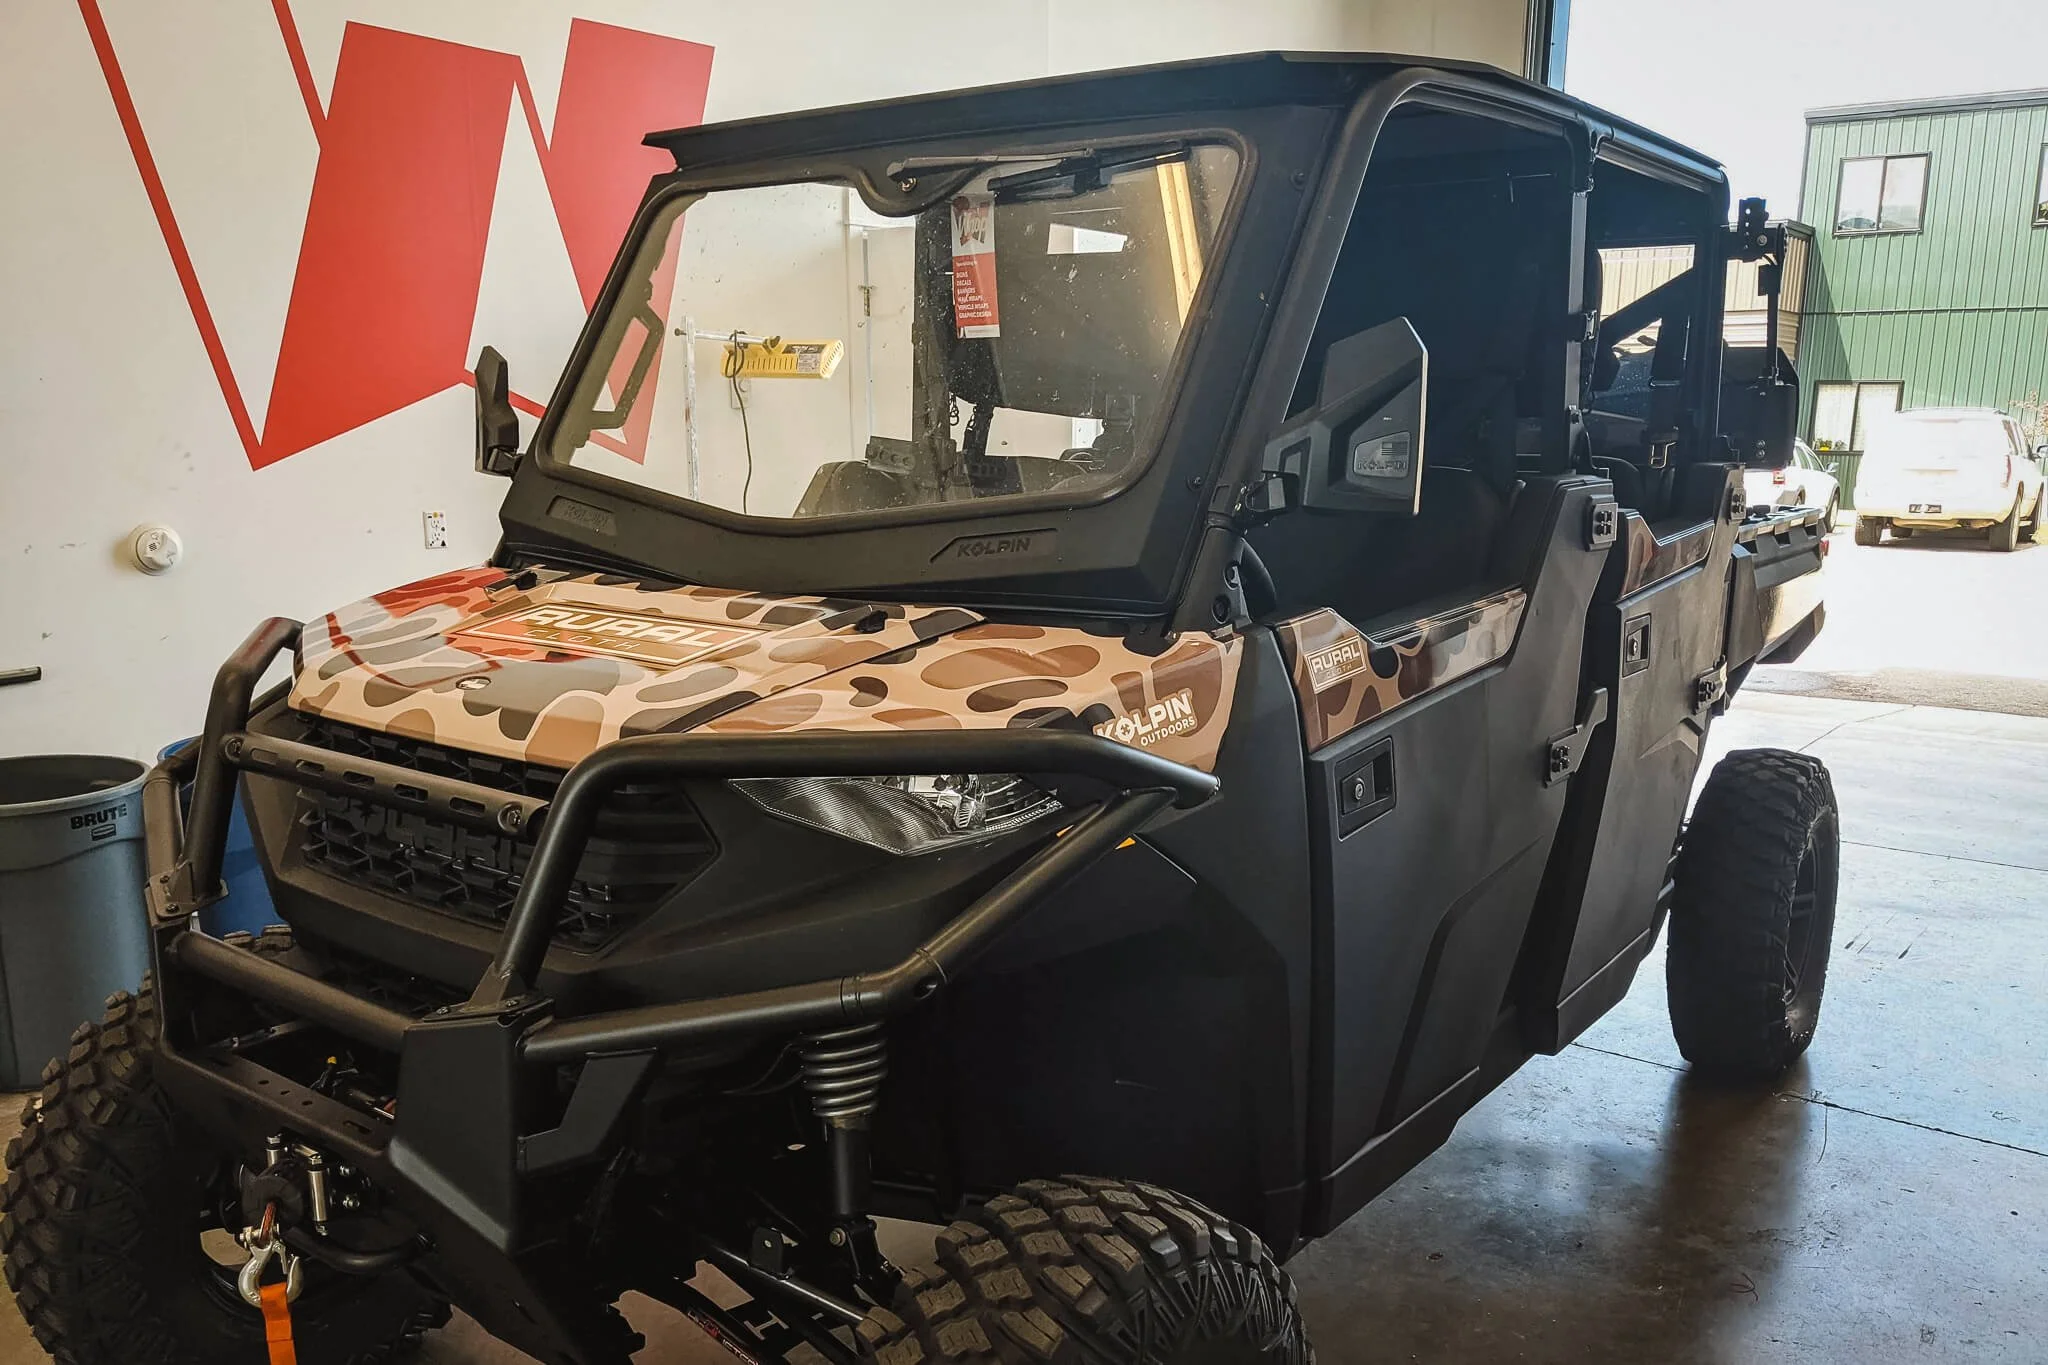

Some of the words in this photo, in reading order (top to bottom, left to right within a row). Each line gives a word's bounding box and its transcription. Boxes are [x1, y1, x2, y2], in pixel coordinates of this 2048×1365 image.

[957, 537, 1031, 558] KOLPIN
[511, 608, 720, 648] RURAL
[523, 629, 641, 651] CLOTH
[1311, 644, 1361, 673] RURAL
[1326, 663, 1353, 679] CLOTH
[1140, 716, 1196, 747] OUTDOORS
[70, 803, 128, 830] BRUTE
